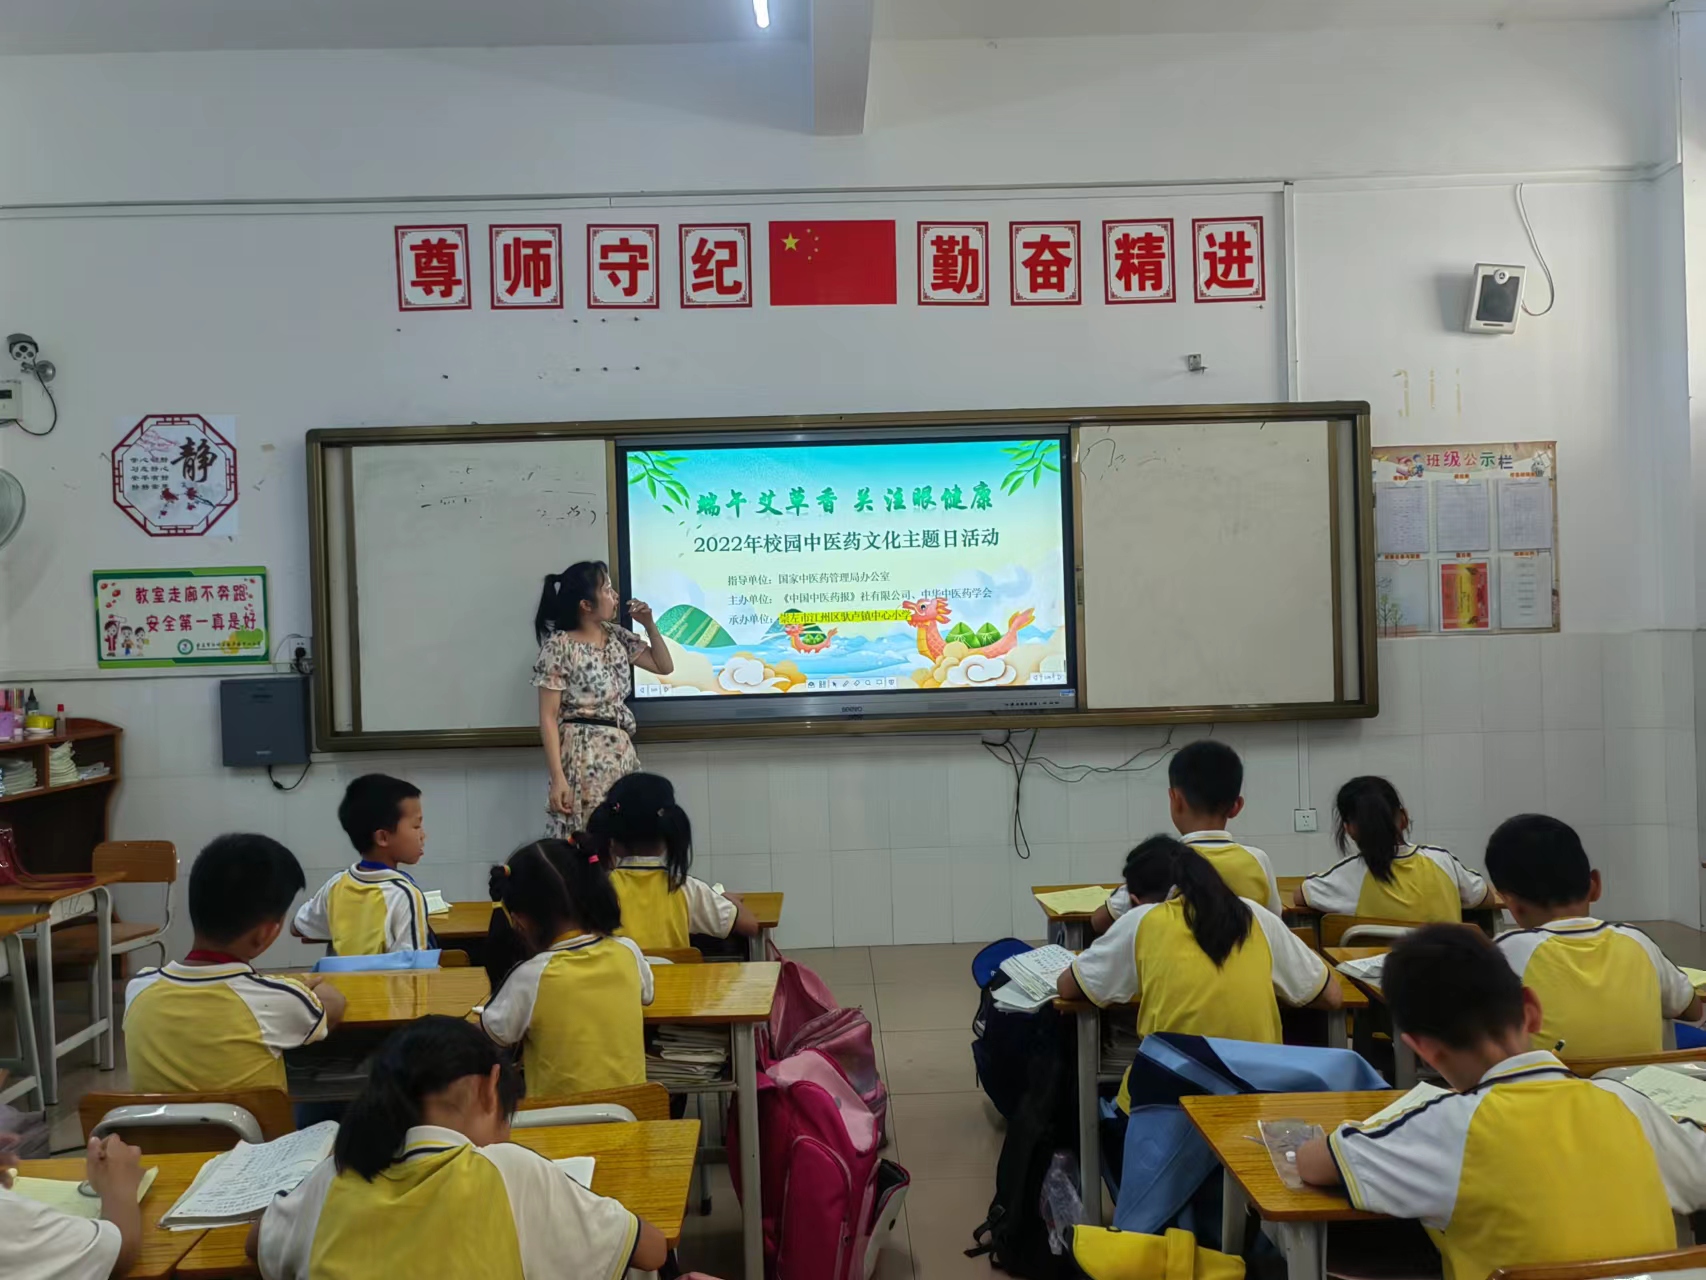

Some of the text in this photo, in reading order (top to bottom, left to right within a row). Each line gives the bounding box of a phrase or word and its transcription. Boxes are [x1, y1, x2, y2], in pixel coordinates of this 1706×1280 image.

[409, 230, 1255, 298] 尊师守纪 勤奋精进
[170, 436, 218, 483] 静
[1426, 450, 1513, 470] 班级公示栏
[696, 480, 993, 518] 端午艾草香 关注眼健康
[694, 527, 999, 554] 2022年校园中医药文化主题日活动
[135, 583, 249, 604] 教室走廊不奔跑
[145, 612, 257, 632] 安全第一真是好
